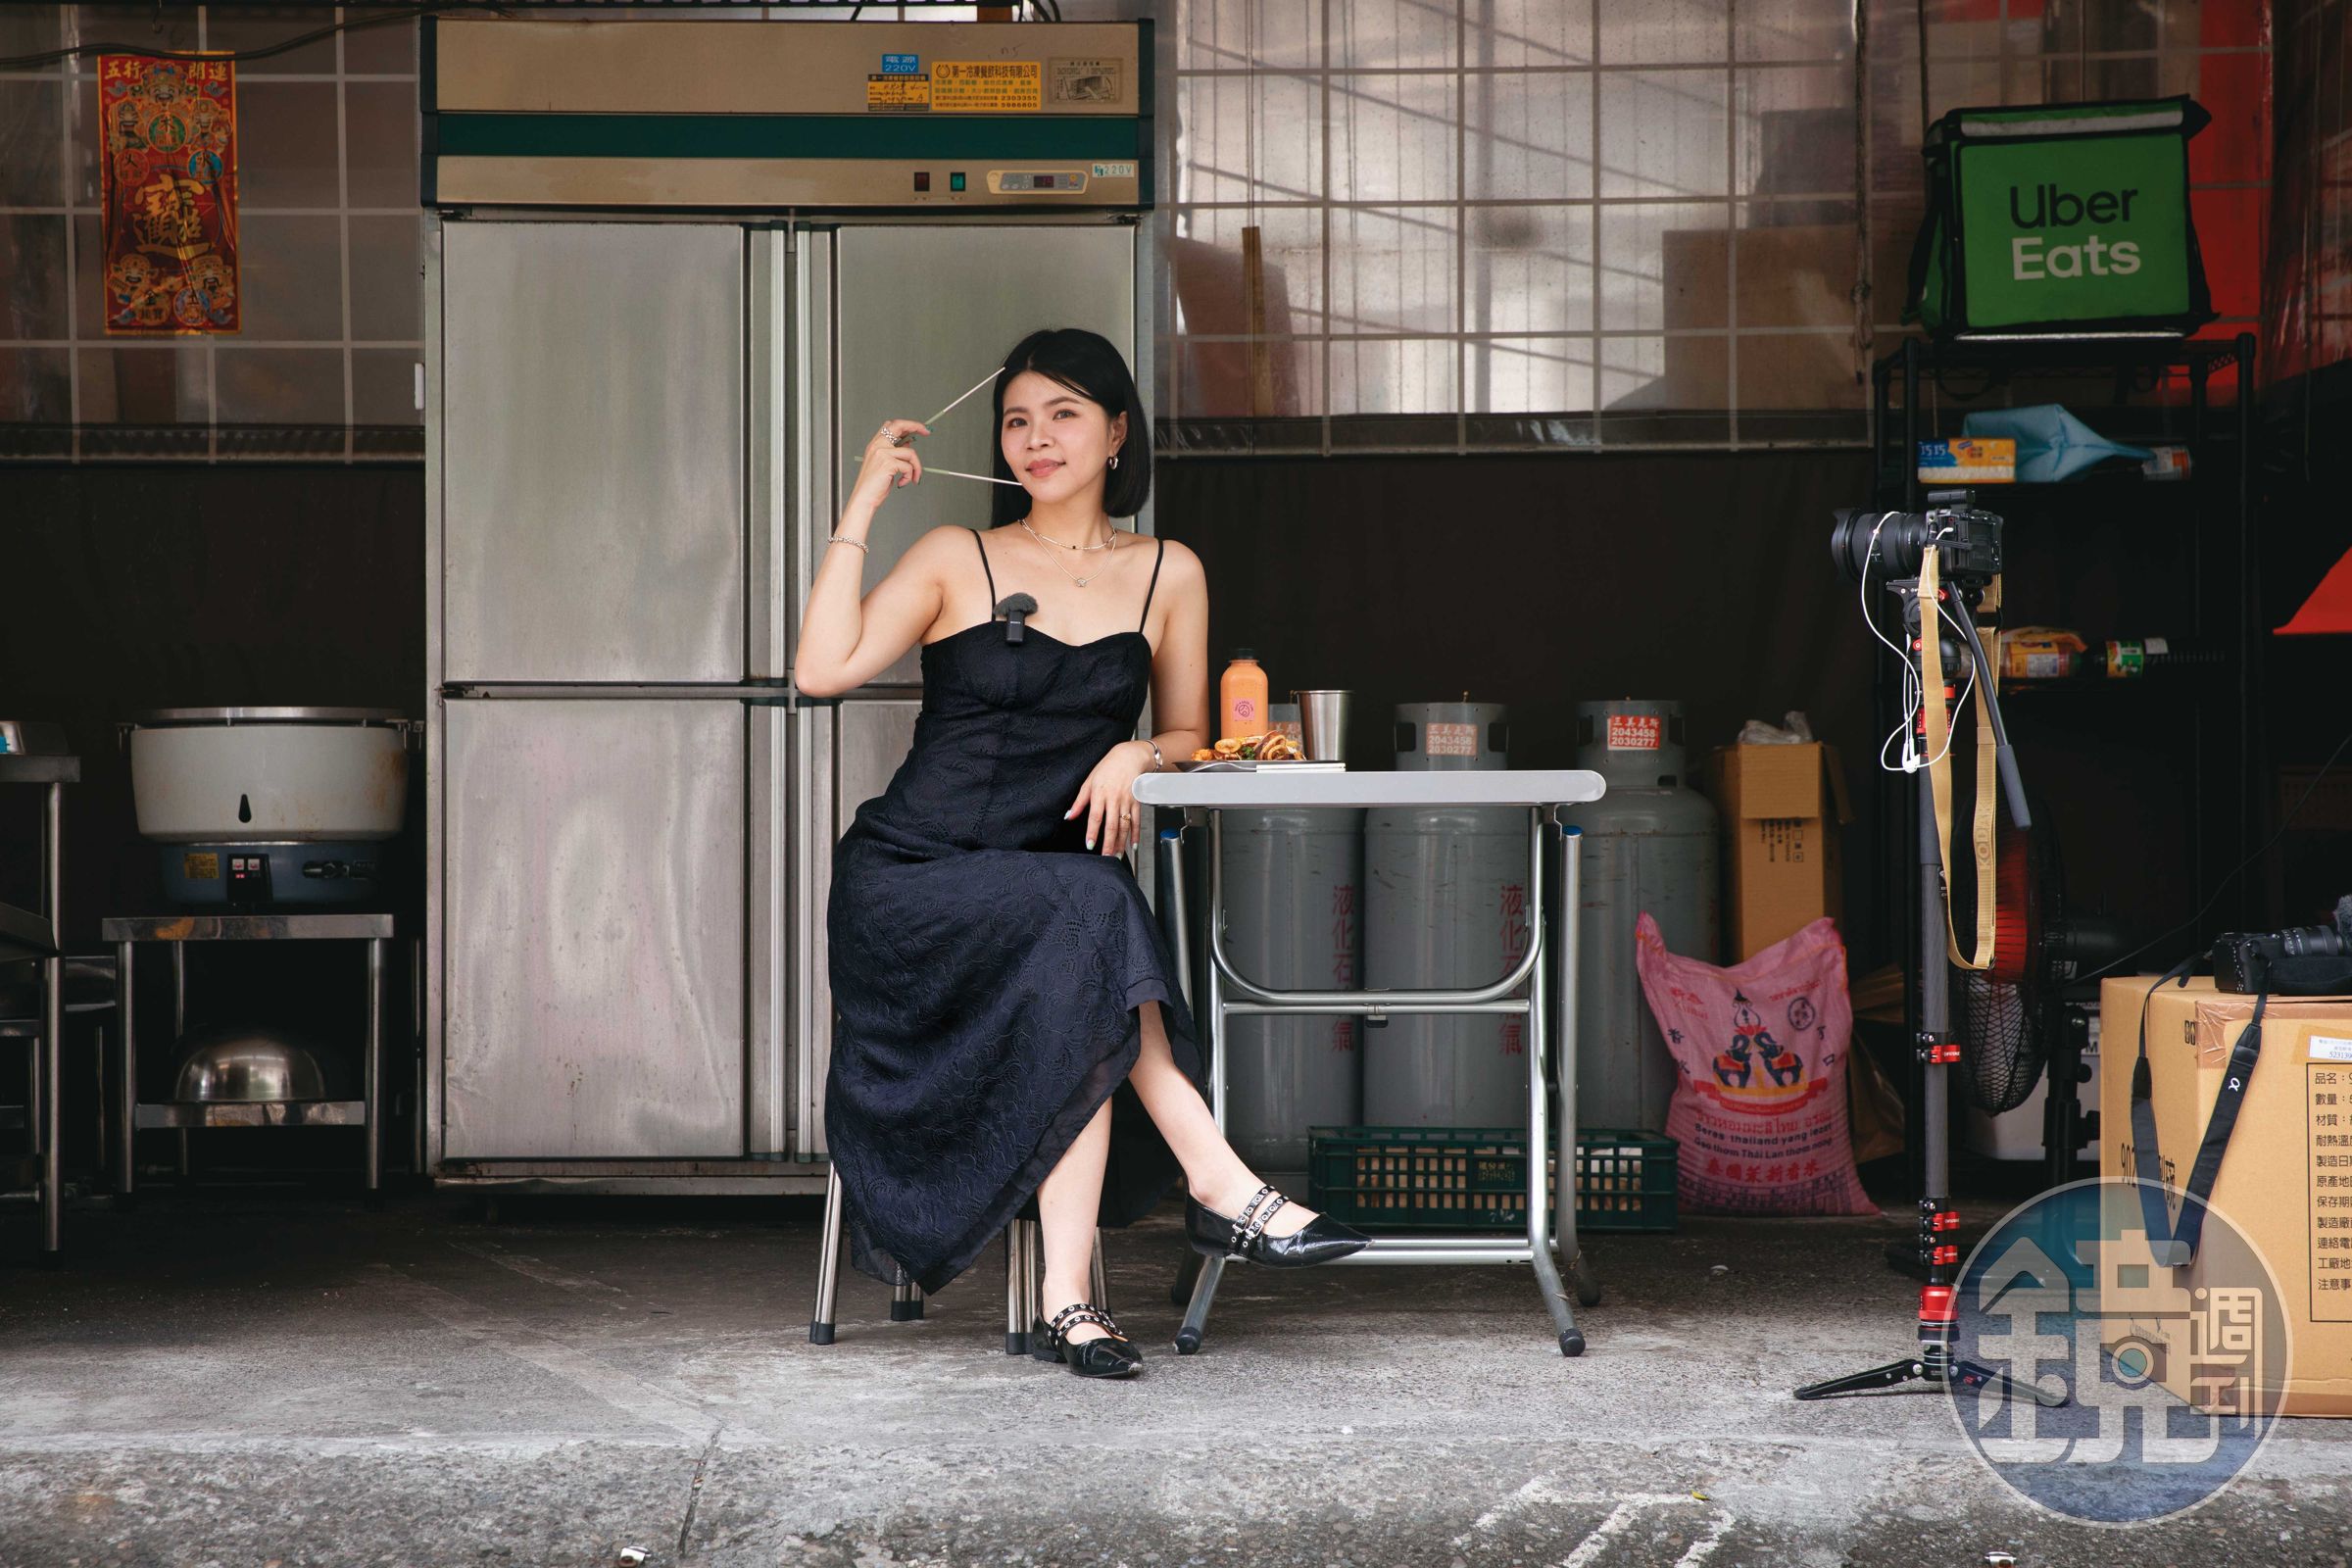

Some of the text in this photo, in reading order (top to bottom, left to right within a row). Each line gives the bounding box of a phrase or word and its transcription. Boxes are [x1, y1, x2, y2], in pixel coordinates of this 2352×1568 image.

[885, 55, 915, 64] 電源
[105, 61, 227, 81] 五行 開運
[885, 64, 916, 73] 220V
[2009, 183, 2138, 229] Uber
[2011, 234, 2141, 281] Eats
[1612, 727, 1656, 738] 2043458
[1428, 736, 1472, 745] 2043458
[1611, 737, 1656, 747] 2030277
[1428, 745, 1472, 754] 2030277
[1332, 884, 1355, 1052] 液化石氣
[2316, 1113, 2352, 1126] 材質：
[2318, 1237, 2352, 1250] 連絡電
[2318, 1257, 2352, 1270] 工廠地
